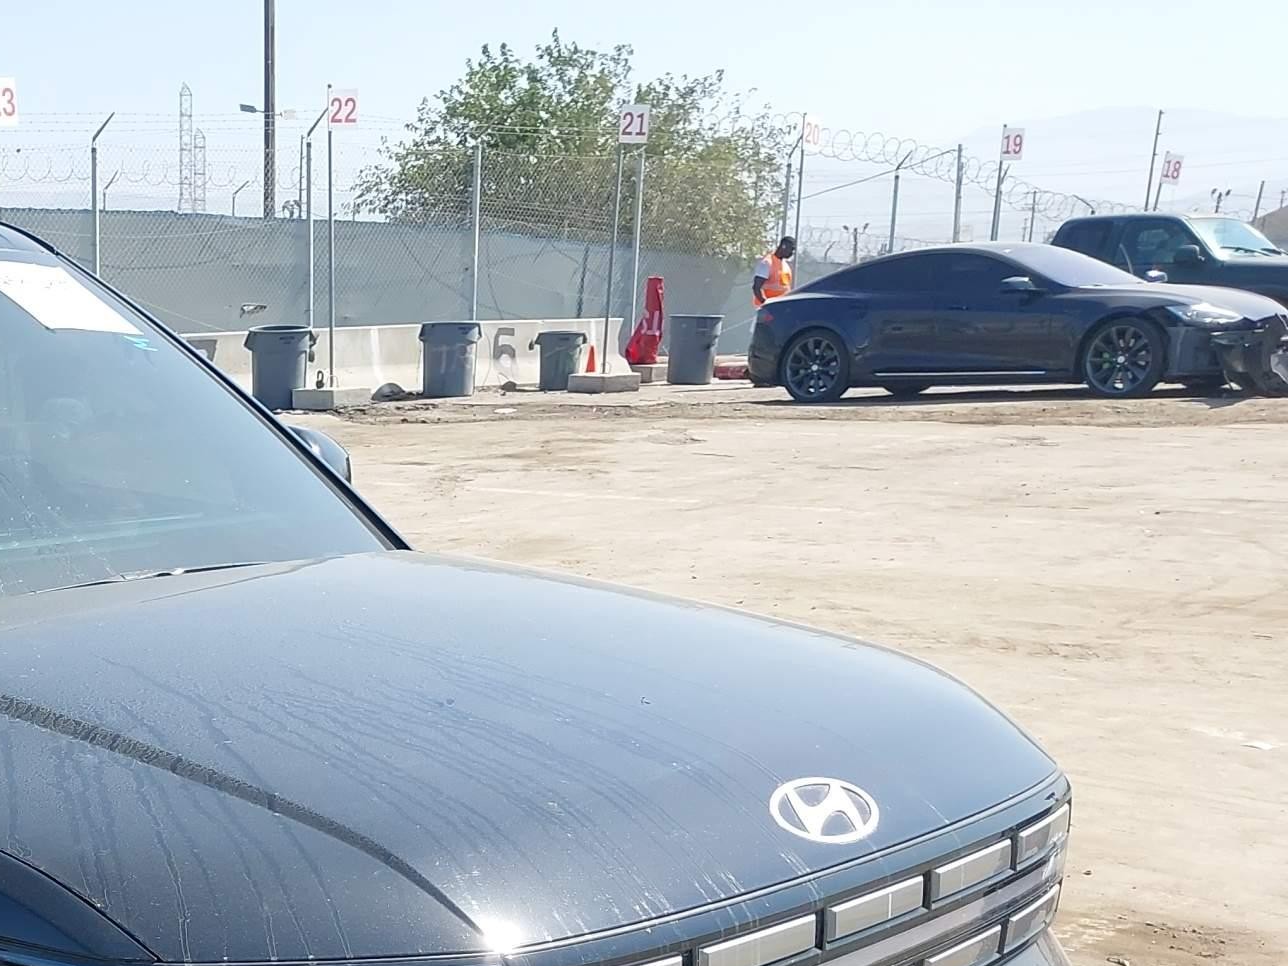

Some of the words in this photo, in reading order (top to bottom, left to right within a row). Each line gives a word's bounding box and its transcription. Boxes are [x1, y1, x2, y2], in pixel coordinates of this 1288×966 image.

[330, 97, 357, 123] 22
[621, 112, 646, 136] 21
[804, 122, 820, 145] 20
[1002, 134, 1023, 154] 19
[1162, 160, 1182, 180] 18
